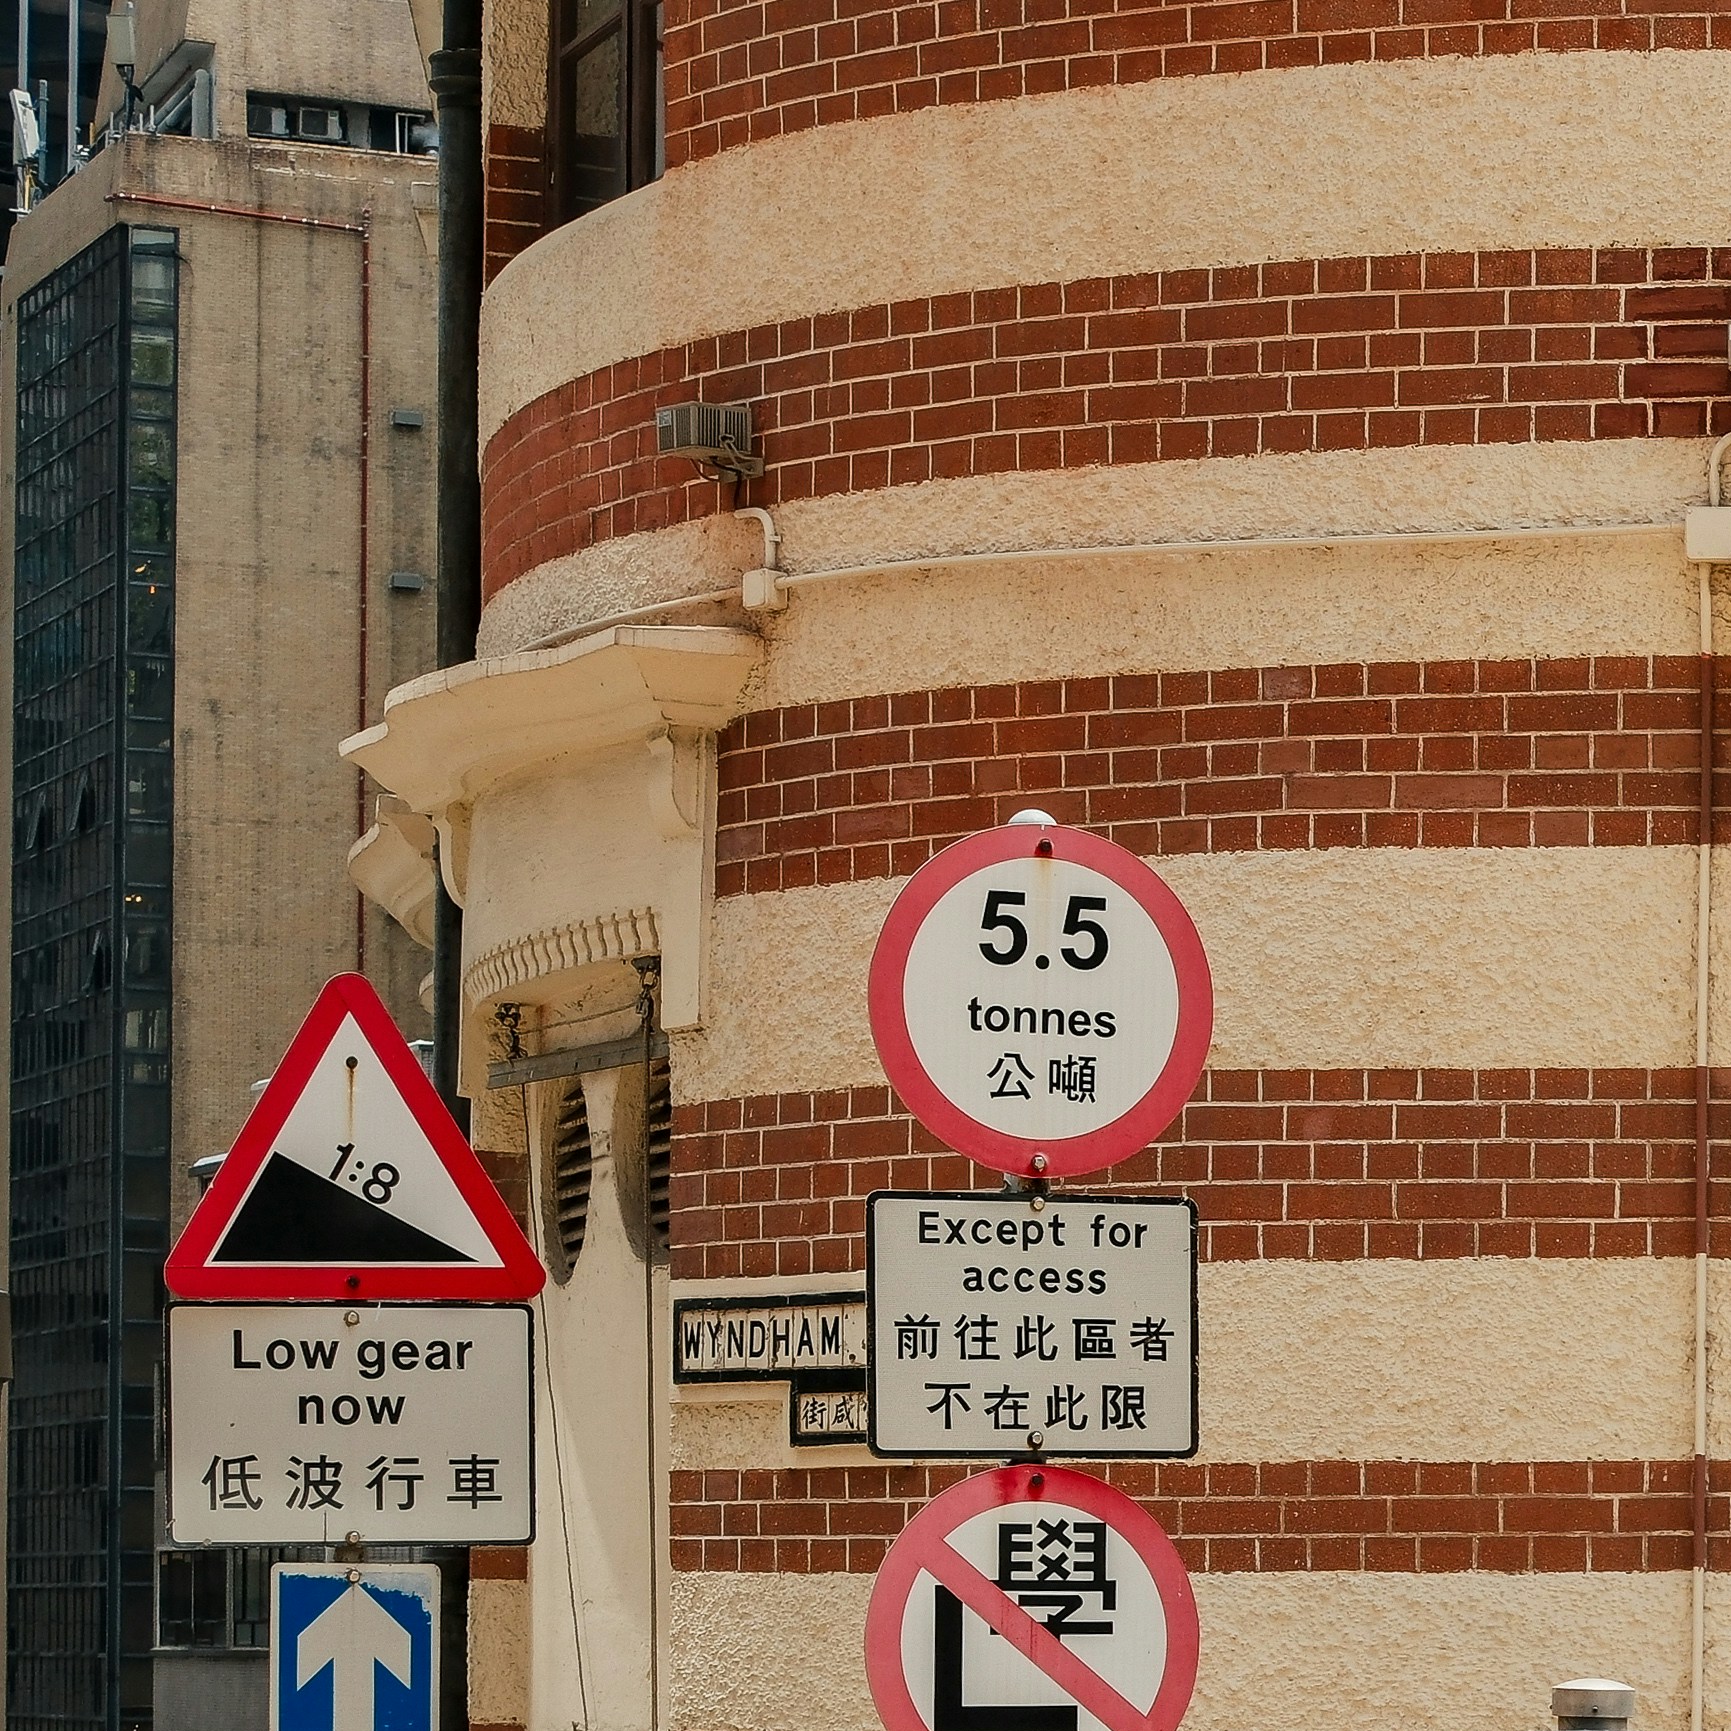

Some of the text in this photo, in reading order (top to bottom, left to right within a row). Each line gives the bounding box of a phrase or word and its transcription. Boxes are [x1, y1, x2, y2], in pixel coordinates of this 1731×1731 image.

[977, 889, 1110, 973] 5.5
[967, 996, 1117, 1038] tonnes
[986, 1052, 1097, 1104] 公噸
[329, 1141, 401, 1204] 1:8
[918, 1212, 1148, 1252] Except for
[962, 1266, 1107, 1295] access
[233, 1329, 473, 1379] Low gear
[683, 1315, 841, 1360] WYNDHAM
[893, 1313, 1175, 1362] 前往此區者
[298, 1394, 406, 1426] now
[924, 1382, 1147, 1434] 不在此限
[201, 1453, 503, 1511] 低波行車
[989, 1517, 1117, 1637] 學
